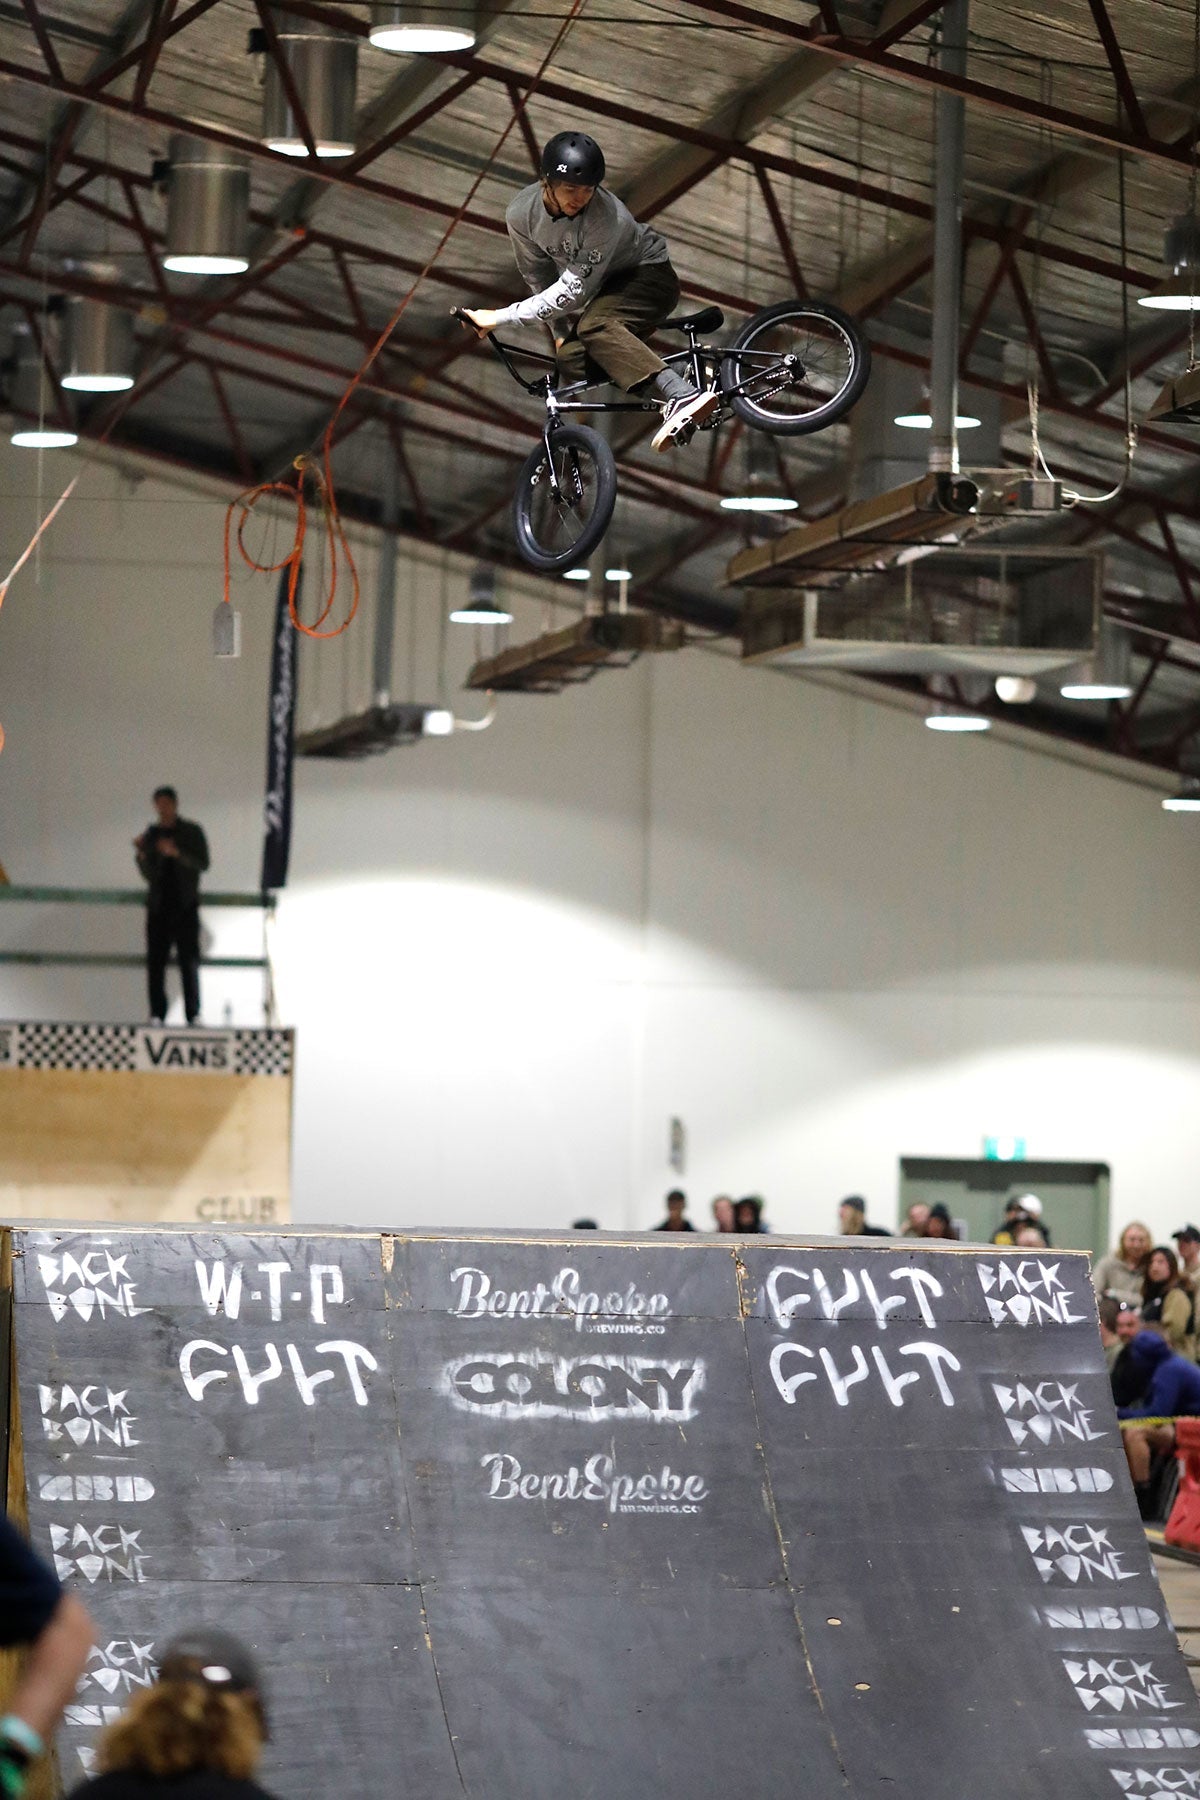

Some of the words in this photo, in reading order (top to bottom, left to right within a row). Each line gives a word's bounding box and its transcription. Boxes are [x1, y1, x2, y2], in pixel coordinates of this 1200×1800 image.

[145, 1036, 229, 1068] VANS
[196, 1197, 277, 1220] CLUB
[37, 1249, 132, 1288] BACK
[976, 1259, 1066, 1296] BACK
[46, 1283, 154, 1323] BONE
[766, 1265, 944, 1330] CULT
[984, 1291, 1088, 1328] BONE
[178, 1339, 378, 1406] CULT
[453, 1361, 696, 1412] COLONY
[769, 1341, 961, 1407] CULT
[38, 1384, 130, 1418] BACK
[992, 1380, 1086, 1414] BACK
[41, 1416, 140, 1448] BONE
[1004, 1409, 1109, 1446] BONE
[49, 1522, 144, 1556] BACK
[1020, 1523, 1116, 1555] BACK
[53, 1553, 153, 1584] BONE
[1032, 1551, 1141, 1584] BONE
[86, 1639, 158, 1669] ACK
[1062, 1658, 1161, 1688] BACK
[1074, 1683, 1186, 1712] BONE
